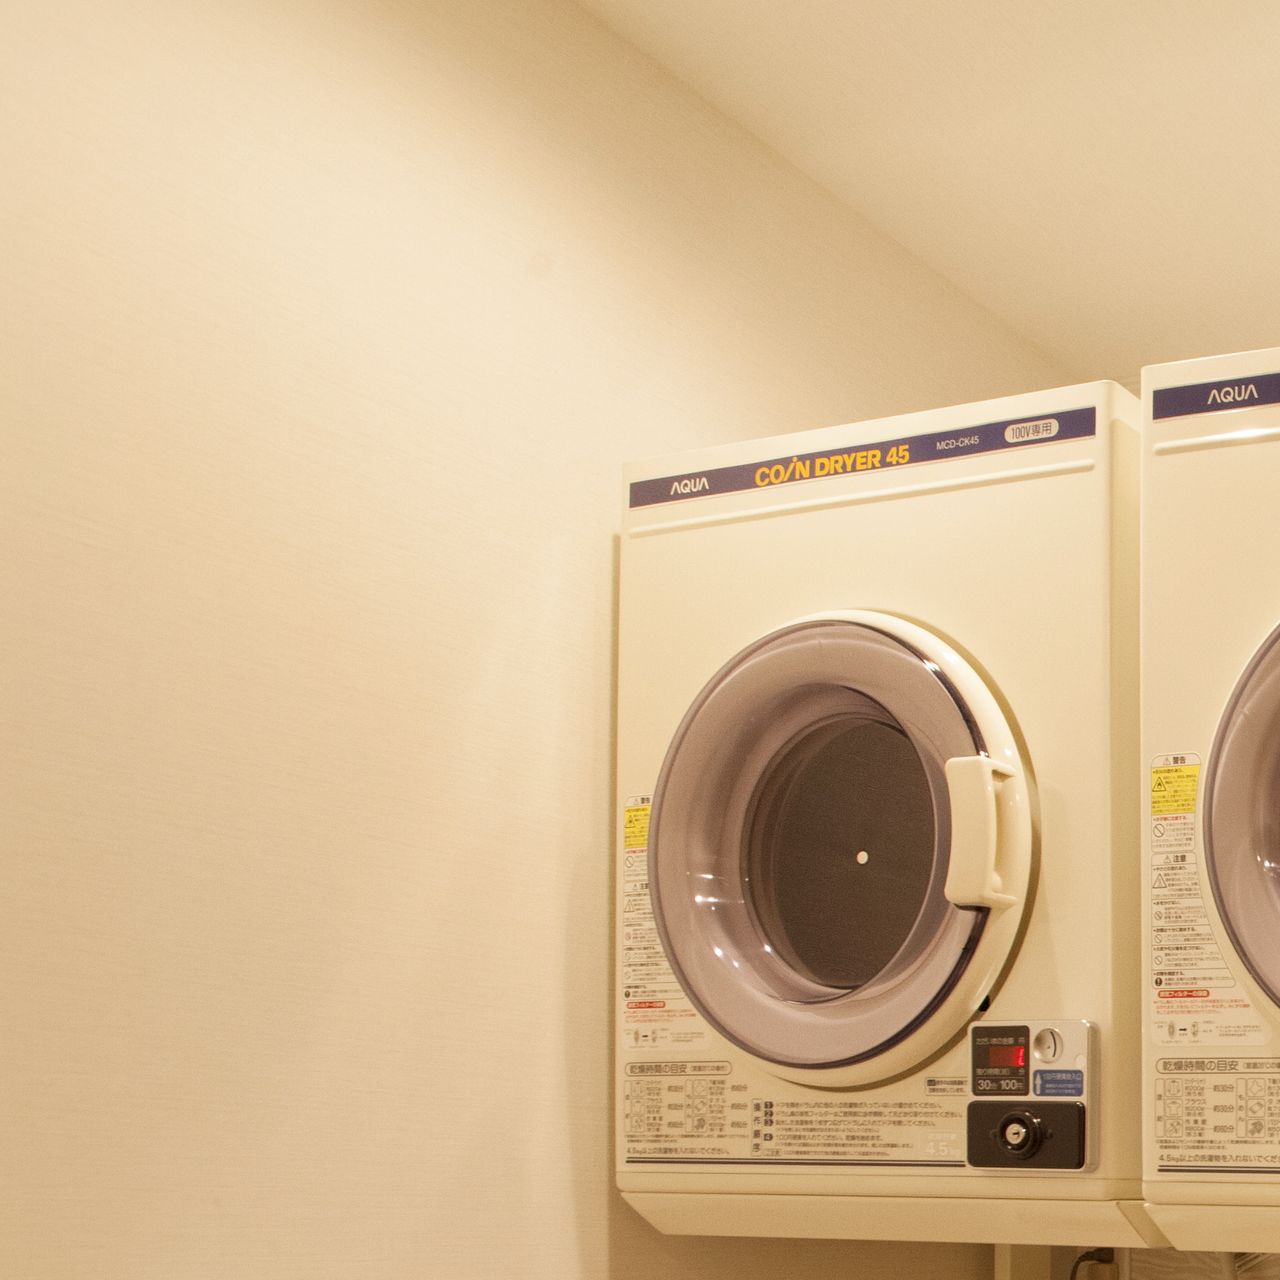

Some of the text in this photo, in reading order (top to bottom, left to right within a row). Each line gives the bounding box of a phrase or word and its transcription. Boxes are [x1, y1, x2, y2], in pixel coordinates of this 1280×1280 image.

[1207, 384, 1258, 405] AQUA
[1010, 421, 1053, 440] 100V専用
[936, 435, 980, 451] MCD-CK45
[815, 449, 882, 478] DRYER
[886, 444, 910, 465] 45
[671, 476, 709, 496] AQUA
